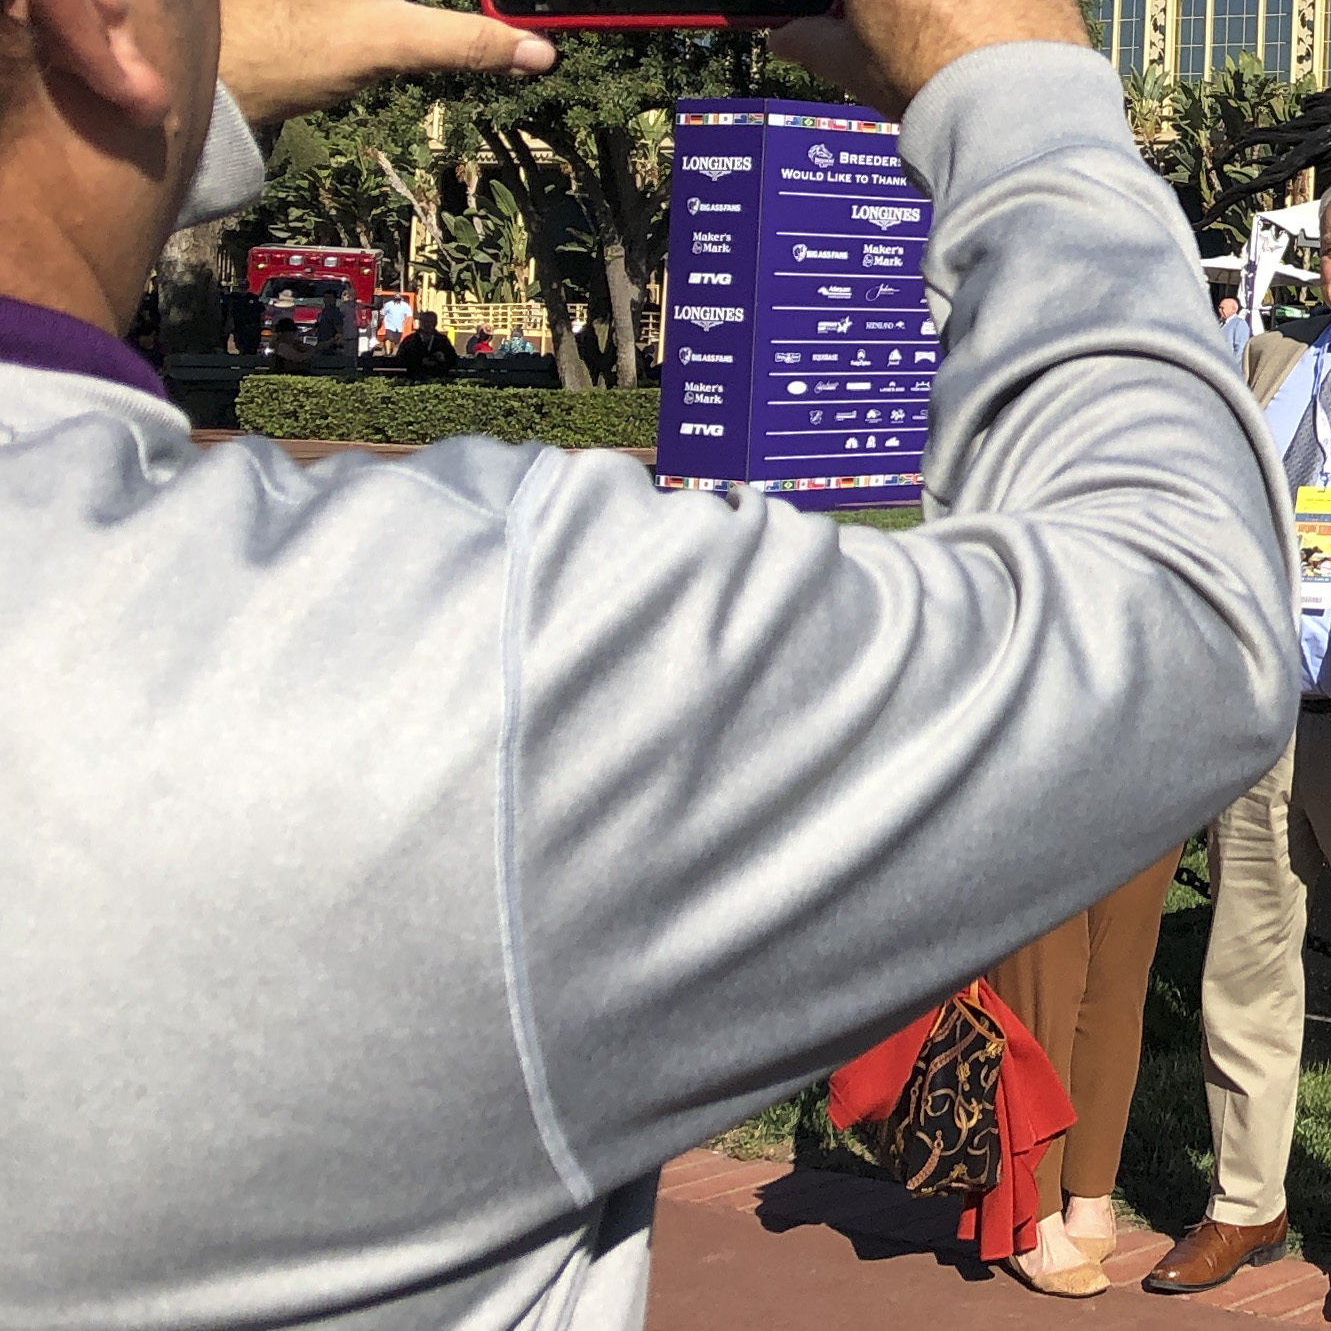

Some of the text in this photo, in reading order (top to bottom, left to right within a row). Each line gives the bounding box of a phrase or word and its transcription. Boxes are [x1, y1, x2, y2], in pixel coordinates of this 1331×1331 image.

[681, 156, 753, 171] LONGINES
[851, 205, 921, 222] LONGINES
[692, 231, 732, 242] Maker's
[702, 243, 731, 253] Mark
[863, 243, 904, 255] Maker's
[873, 256, 903, 267] Mark
[702, 272, 733, 285] TVG
[674, 305, 745, 322] LONGINES
[684, 381, 724, 393] Maker's
[694, 393, 723, 404] Mark
[694, 423, 725, 437] TVG
